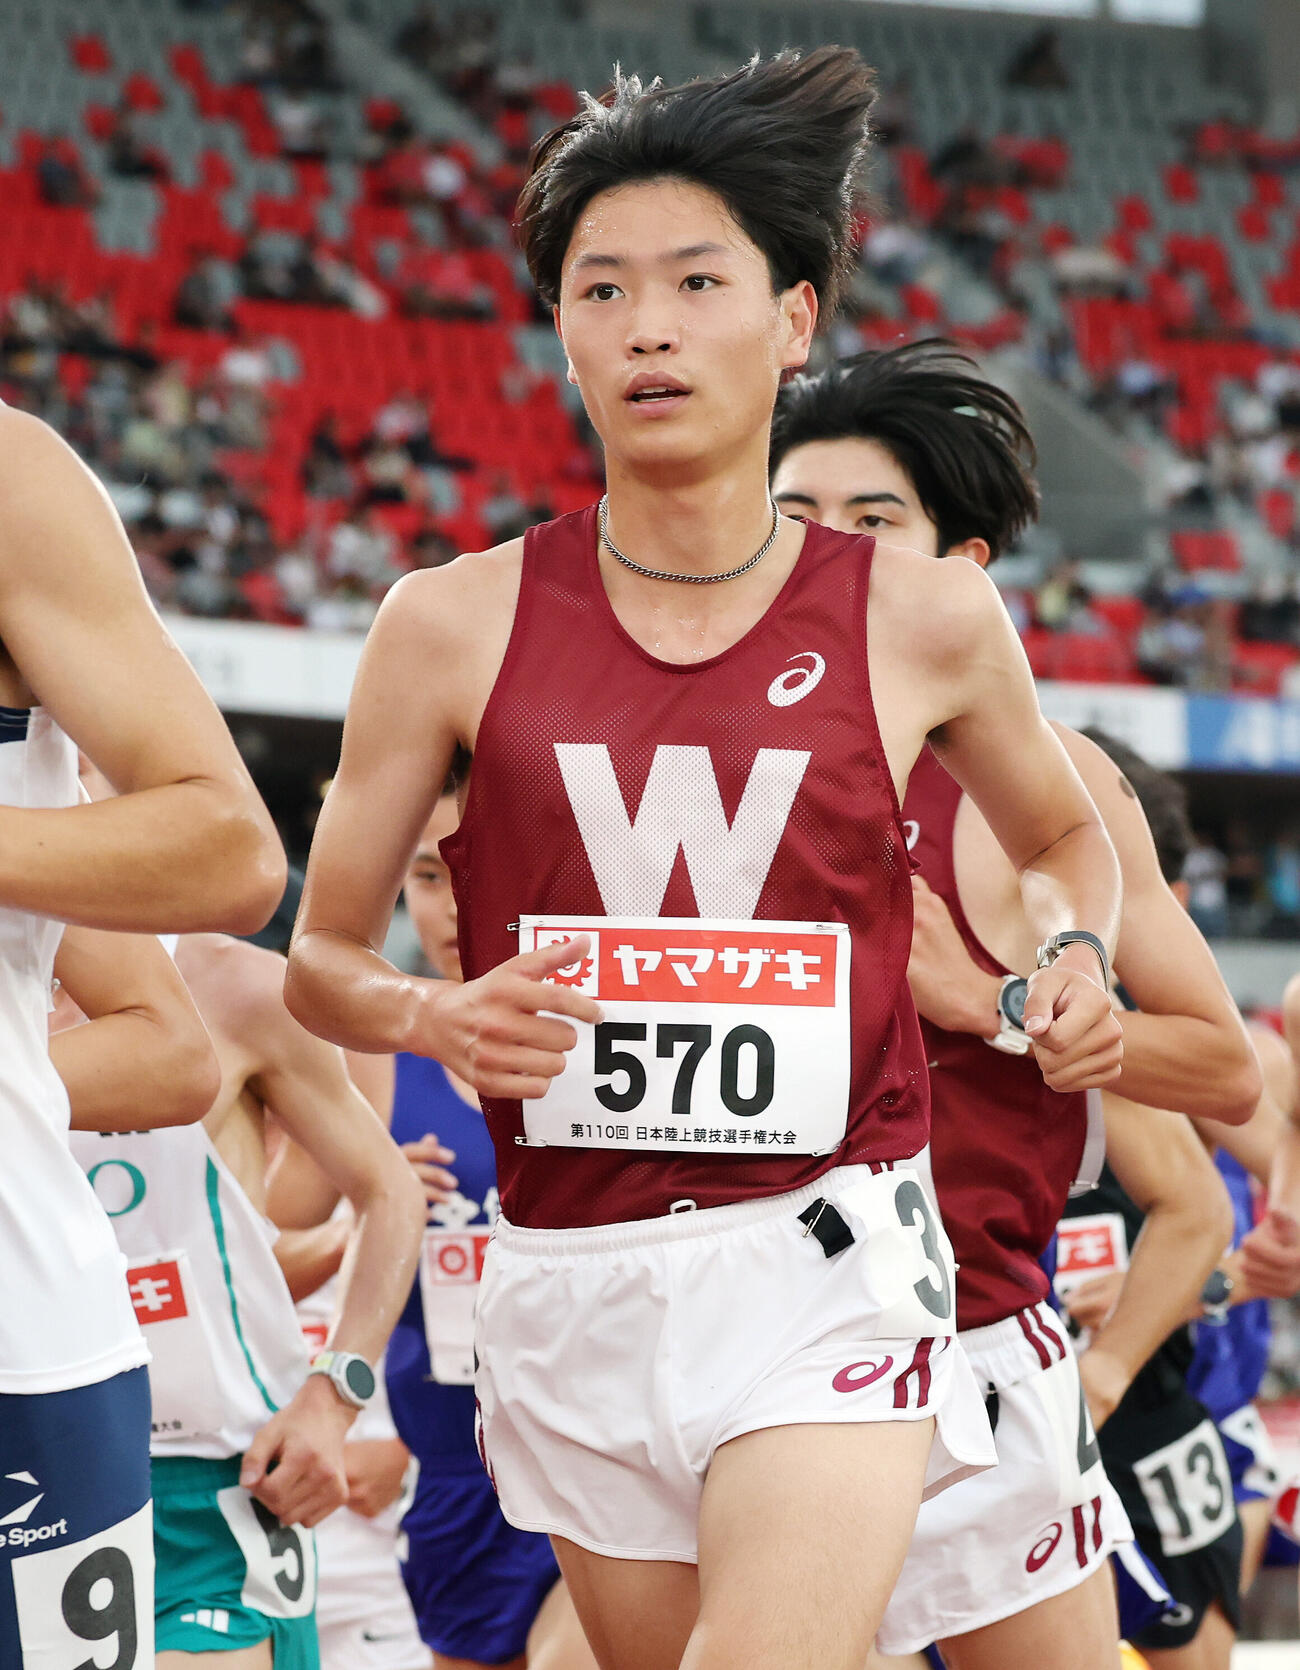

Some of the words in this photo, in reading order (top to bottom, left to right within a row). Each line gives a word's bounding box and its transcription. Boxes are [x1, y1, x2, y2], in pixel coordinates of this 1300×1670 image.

[553, 742, 812, 920] W
[612, 944, 822, 990] ヤマザキ
[594, 1021, 775, 1117] 570
[570, 1123, 629, 1140] 第110回
[636, 1126, 798, 1145] 日本陸上競技選手権大会
[895, 1180, 951, 1319] 3
[1150, 1442, 1224, 1538] 13
[61, 1546, 138, 1670] 9
